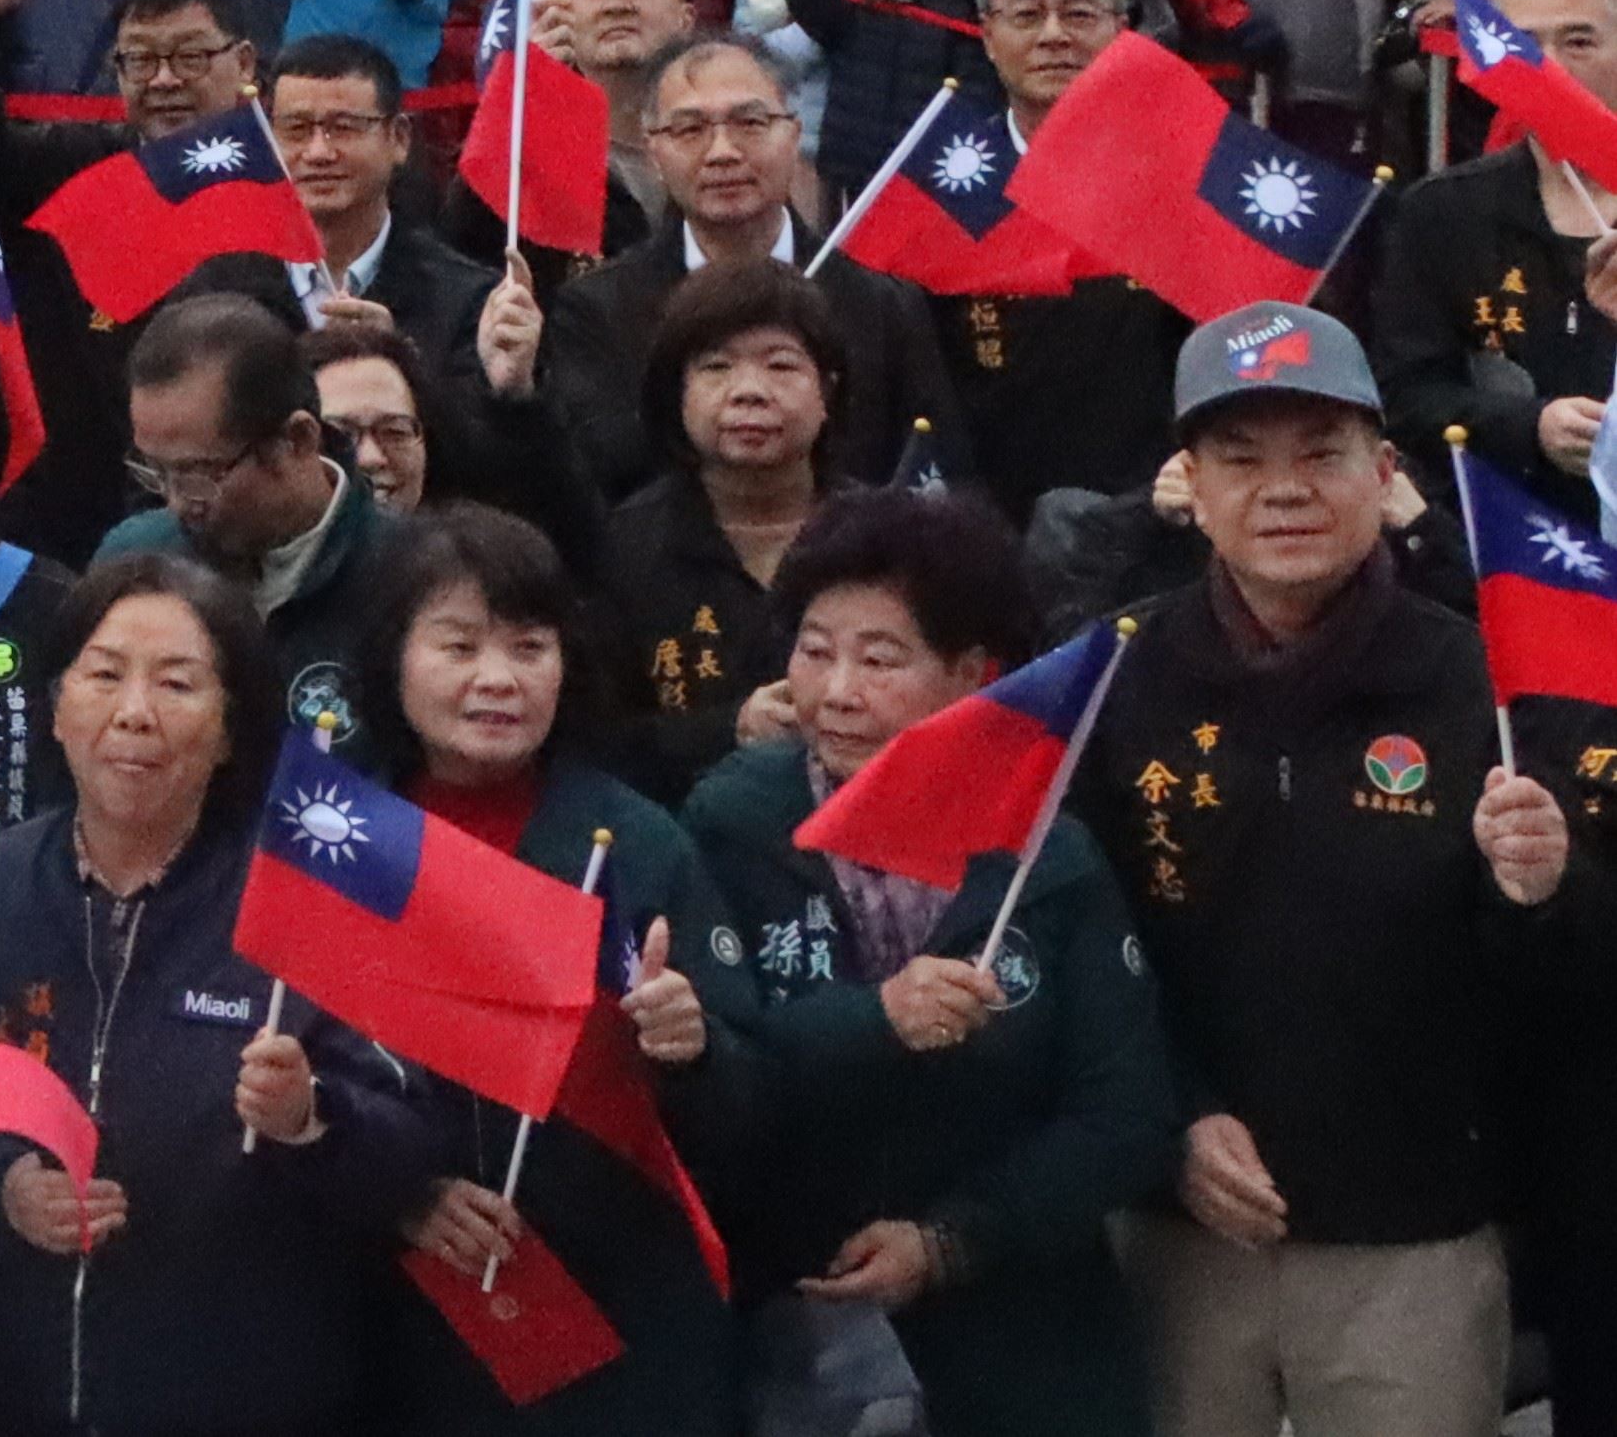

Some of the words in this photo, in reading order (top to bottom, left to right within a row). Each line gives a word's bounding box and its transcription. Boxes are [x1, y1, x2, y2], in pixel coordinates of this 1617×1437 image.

[1227, 315, 1293, 354] Miaoli
[1190, 722, 1223, 808] 市長
[185, 990, 250, 1020] Miaoli
